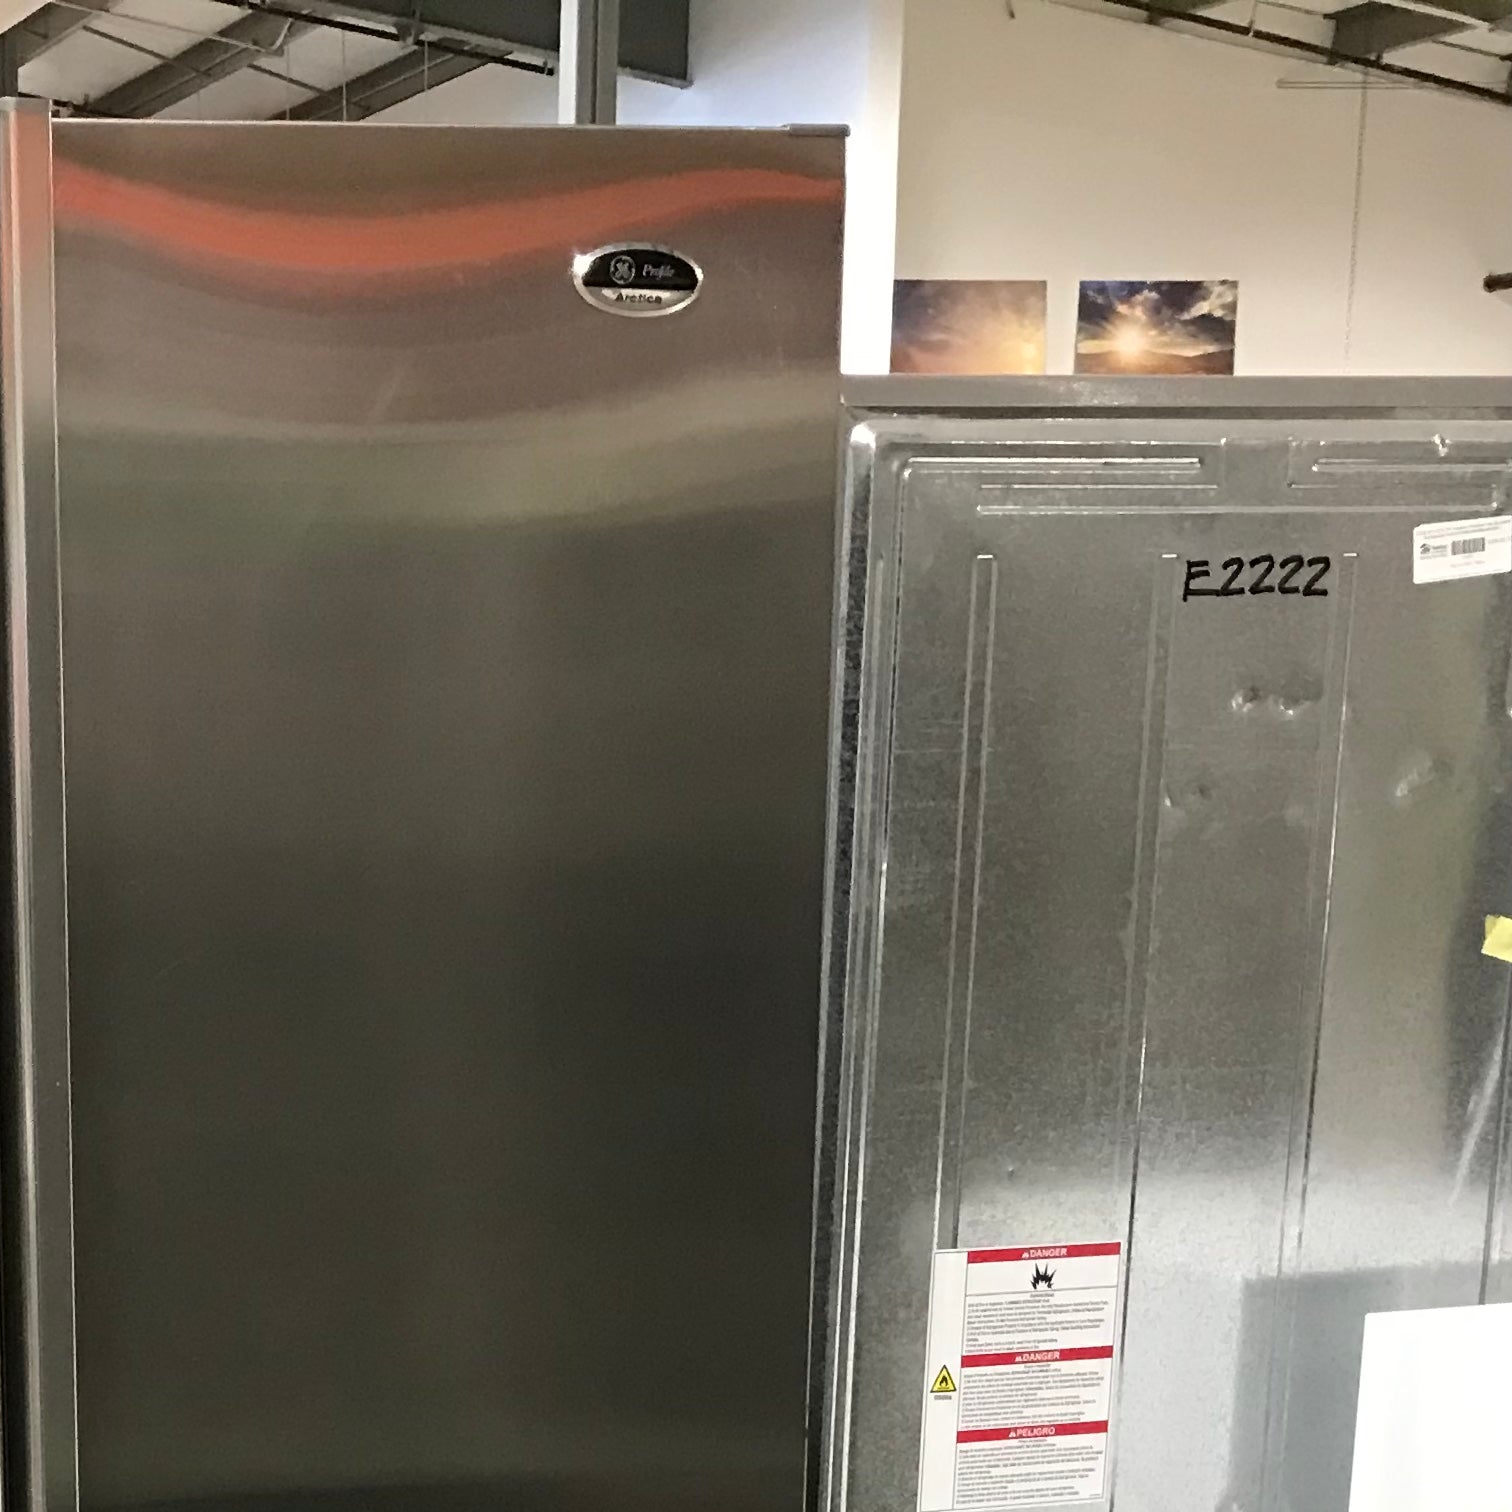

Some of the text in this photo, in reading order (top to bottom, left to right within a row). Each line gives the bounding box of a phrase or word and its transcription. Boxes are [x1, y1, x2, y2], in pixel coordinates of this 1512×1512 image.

[615, 292, 663, 304] Arctica
[1029, 1247, 1068, 1258] DANGER
[1022, 1351, 1060, 1362] DANGER
[1016, 1426, 1056, 1437] PELIGRO
